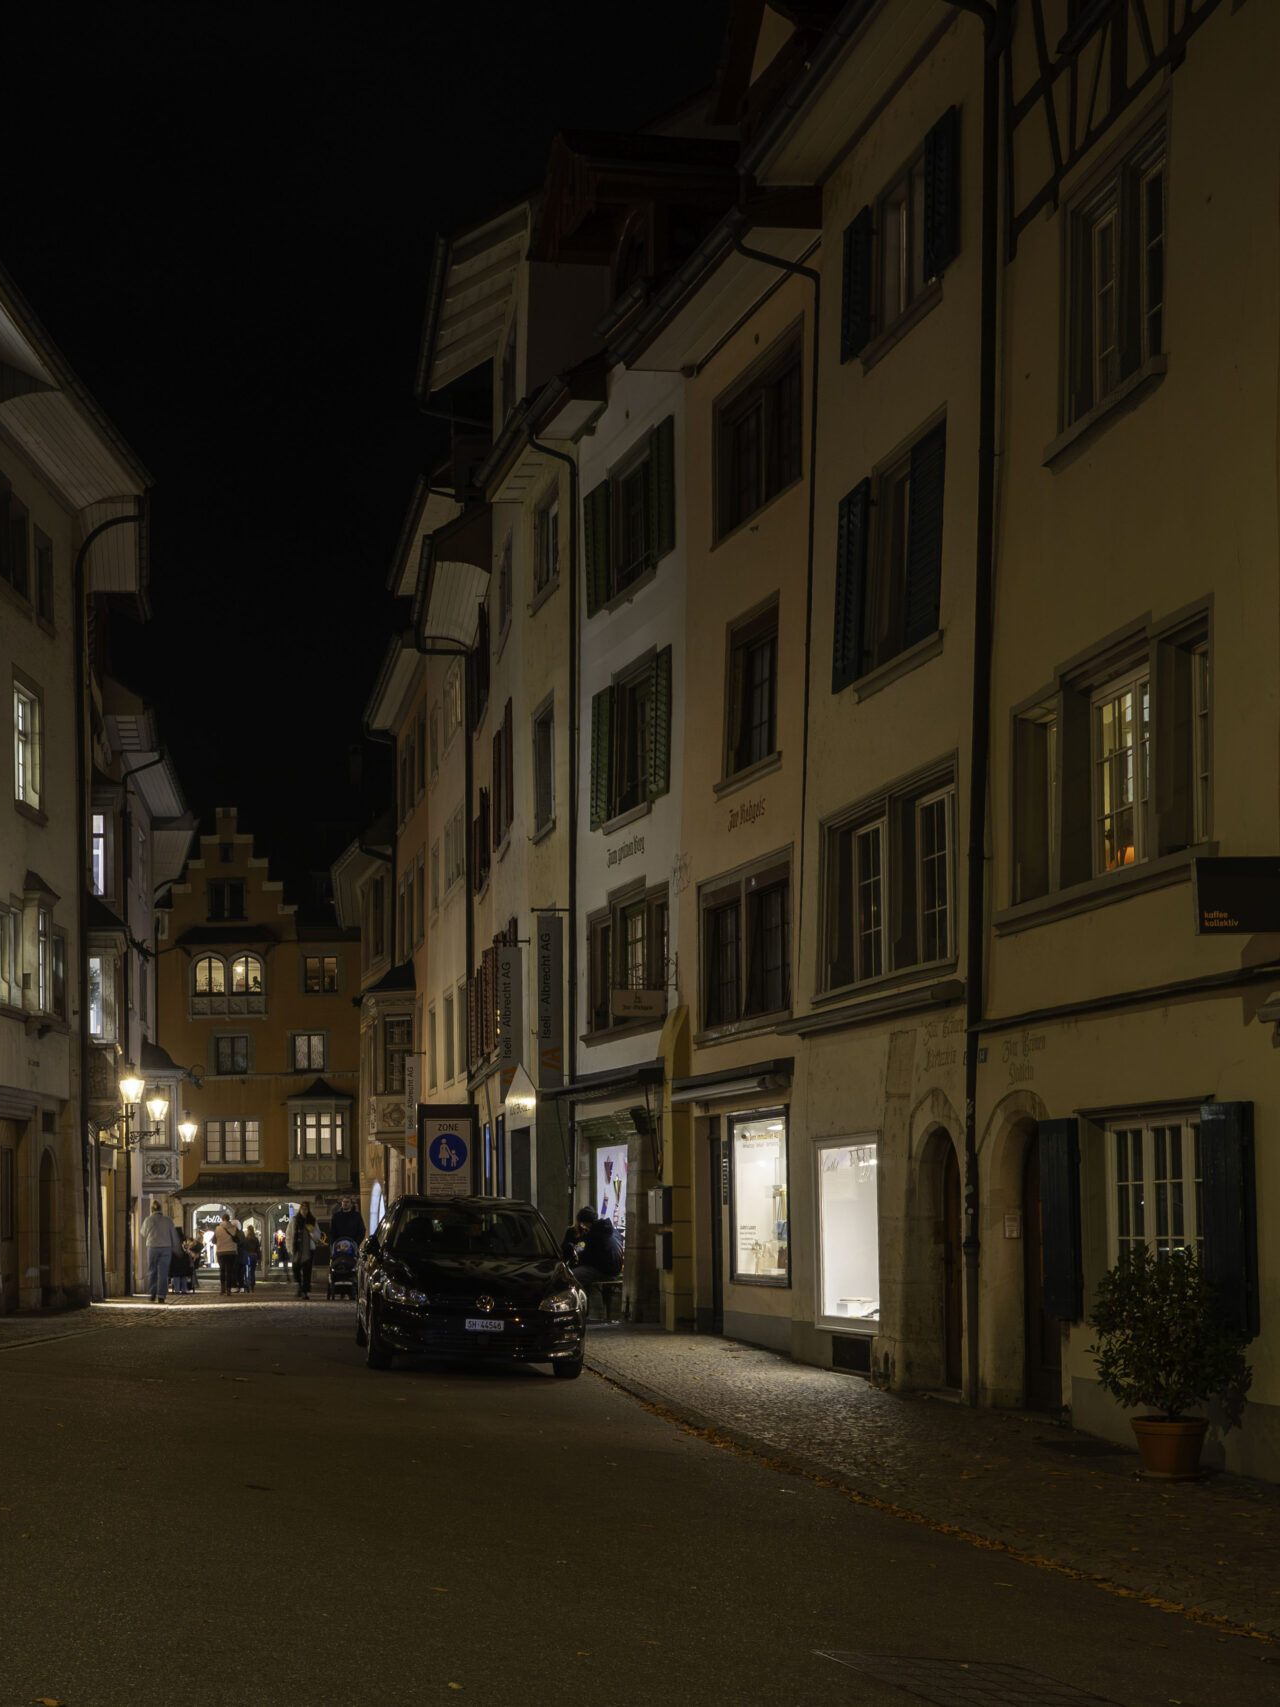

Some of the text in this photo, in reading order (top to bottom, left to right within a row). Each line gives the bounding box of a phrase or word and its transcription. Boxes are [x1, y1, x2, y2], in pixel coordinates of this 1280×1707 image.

[1204, 910, 1229, 919] kaffee
[1204, 918, 1240, 928] kollektiv
[540, 933, 552, 1040] Iseli Albrecht AG
[501, 961, 512, 1059] Iseli Albrecht AG
[438, 1123, 460, 1132] ZONE
